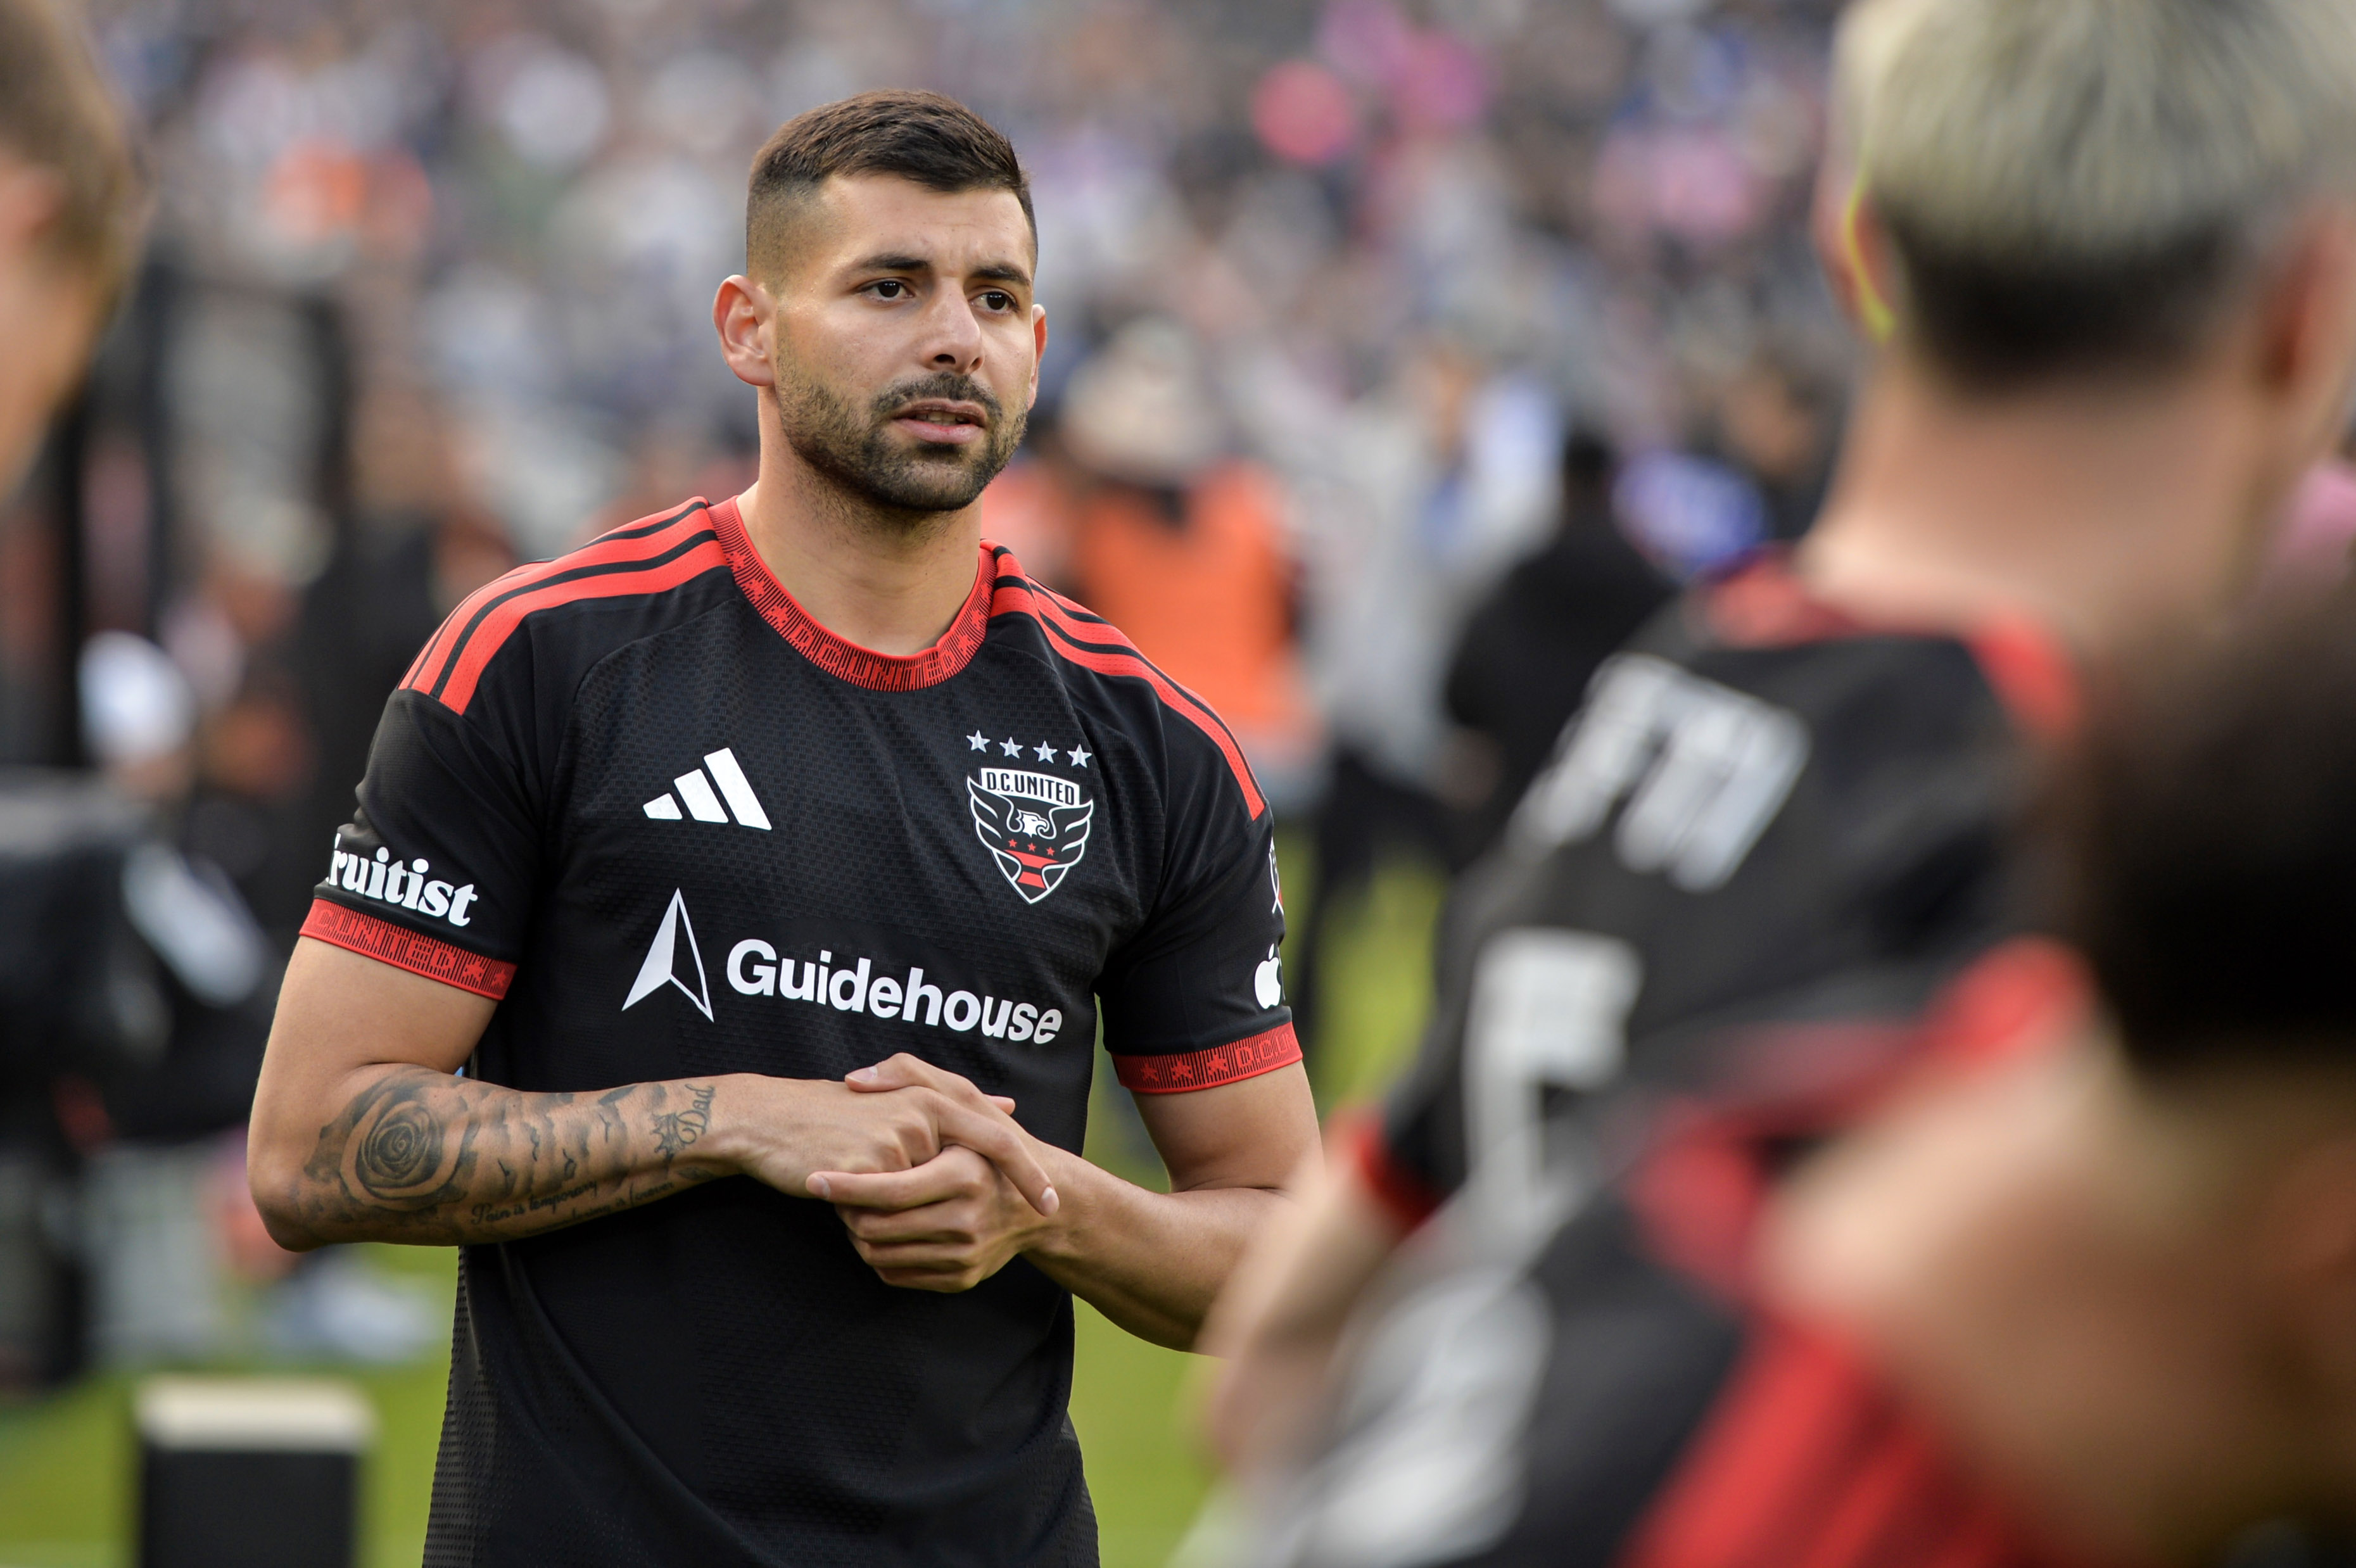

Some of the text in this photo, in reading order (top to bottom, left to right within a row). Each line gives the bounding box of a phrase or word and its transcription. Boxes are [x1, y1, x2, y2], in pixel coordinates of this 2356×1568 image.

[985, 771, 1075, 806] D.C.UNITED
[325, 833, 478, 926] ruitist
[726, 939, 1063, 1044] Guidehouse
[471, 1203, 511, 1225] Pain
[513, 1204, 525, 1215] is
[529, 1180, 598, 1215] temporary
